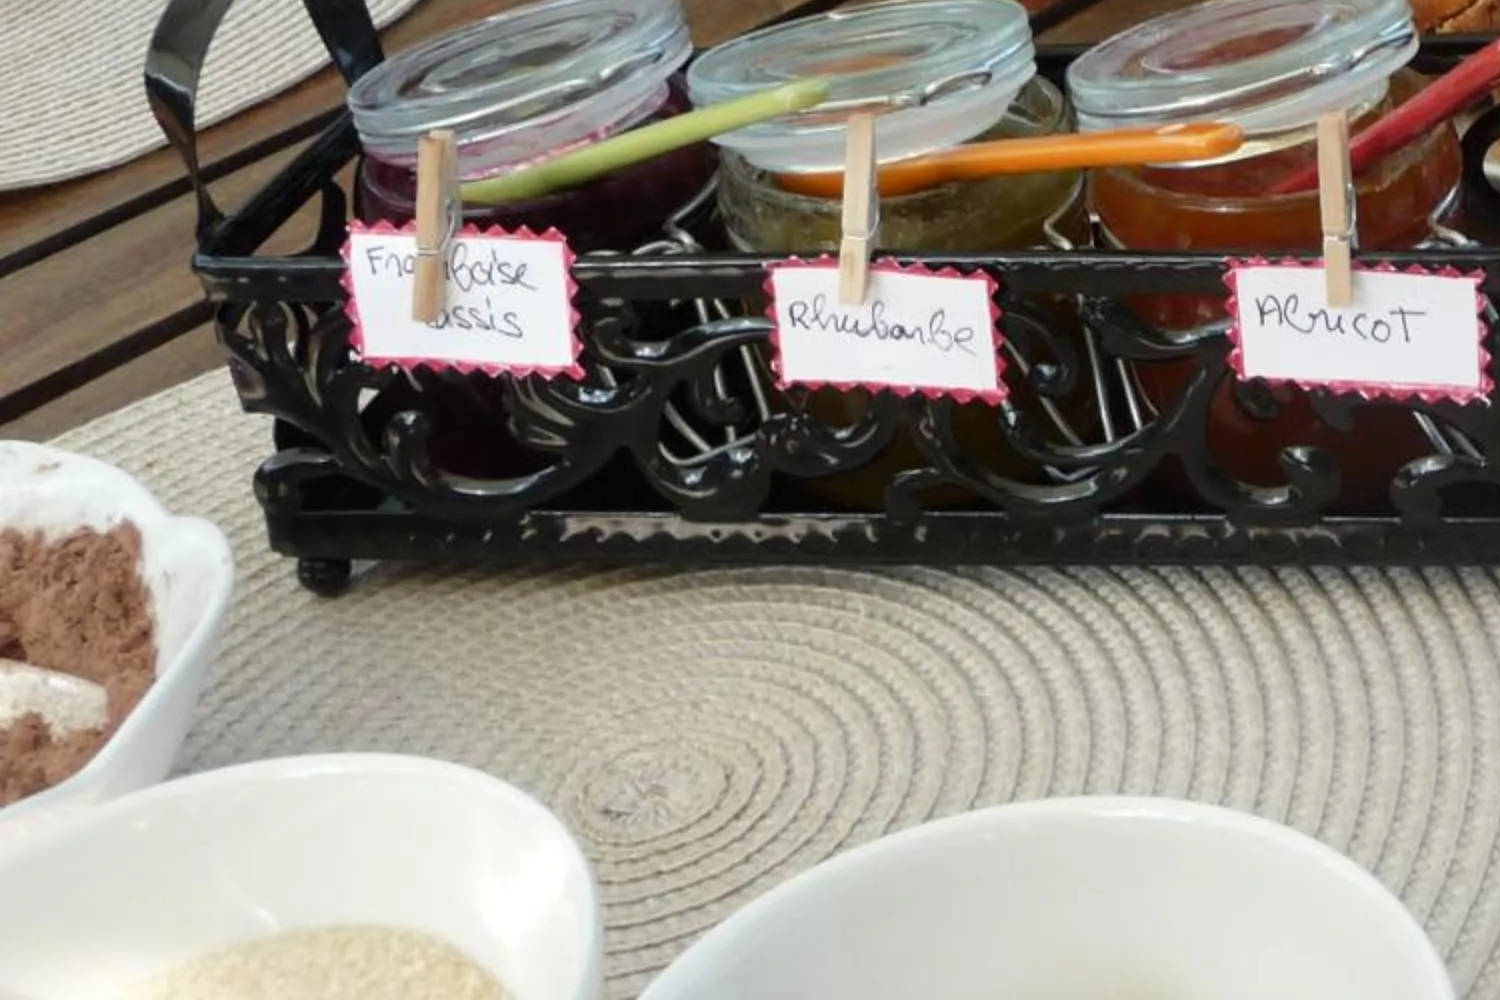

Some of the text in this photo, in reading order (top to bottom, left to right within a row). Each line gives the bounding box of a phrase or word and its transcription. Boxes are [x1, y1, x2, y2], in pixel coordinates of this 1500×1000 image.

[366, 242, 537, 292] Fraboise
[424, 297, 523, 338] assis
[788, 293, 977, 357] Rhubarbe
